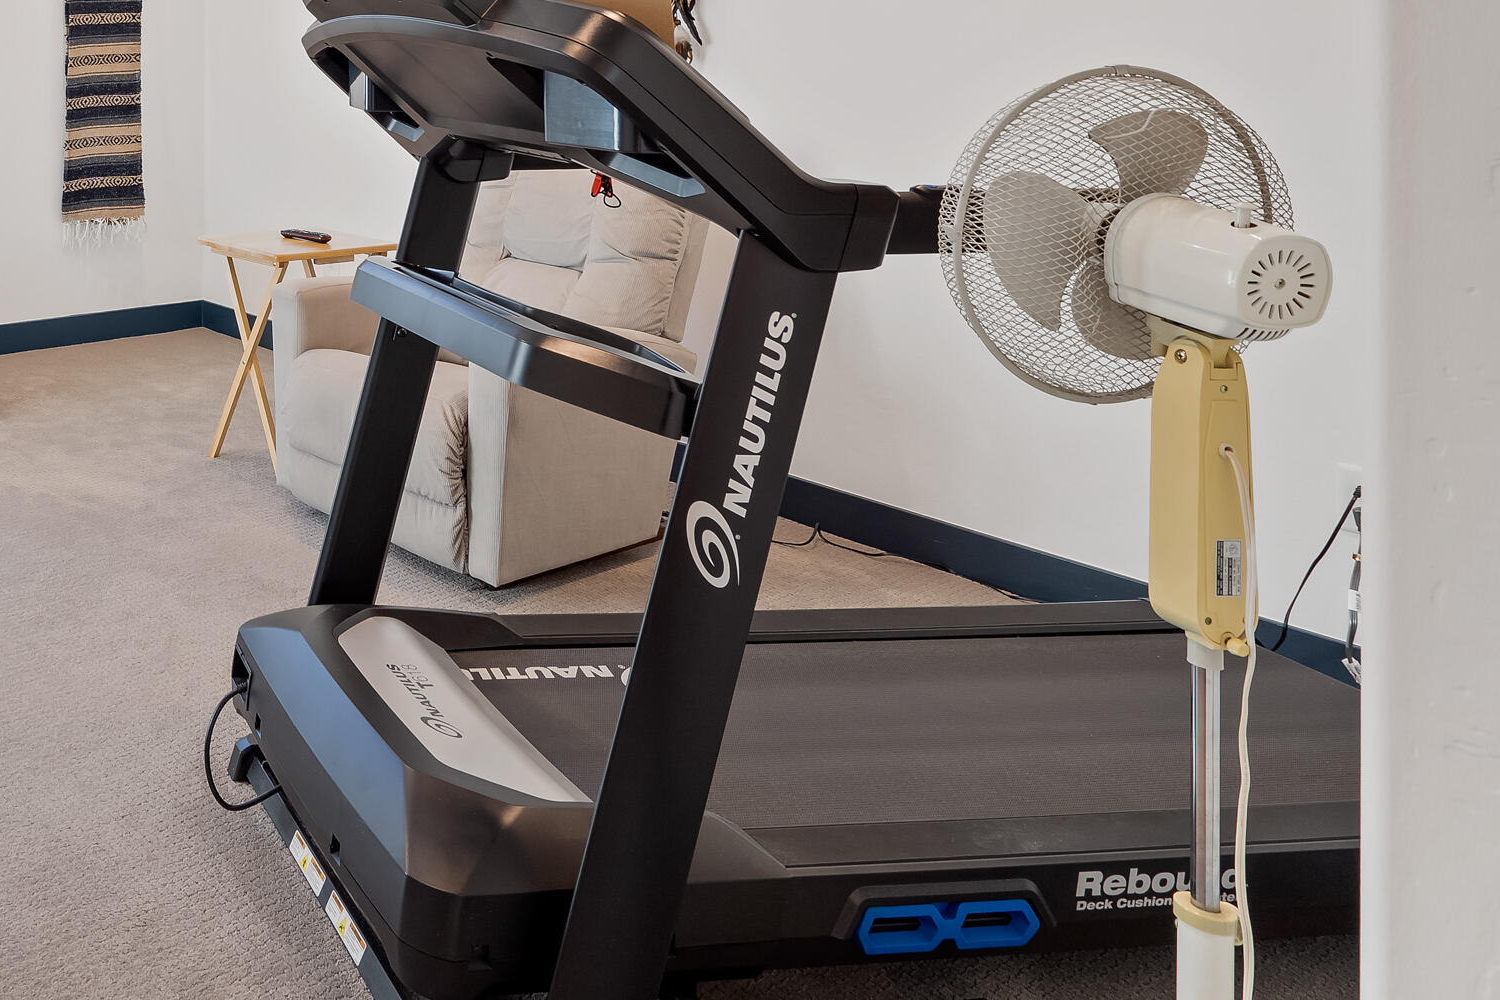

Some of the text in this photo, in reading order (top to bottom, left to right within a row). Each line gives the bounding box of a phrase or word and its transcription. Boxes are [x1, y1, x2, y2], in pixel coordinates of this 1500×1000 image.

[722, 310, 795, 518] NAUTILUS
[460, 665, 614, 681] NAUTIL
[386, 663, 445, 718] NAUTILUS
[1075, 868, 1236, 897] Rebou
[1076, 896, 1173, 911] Deck Cushion
